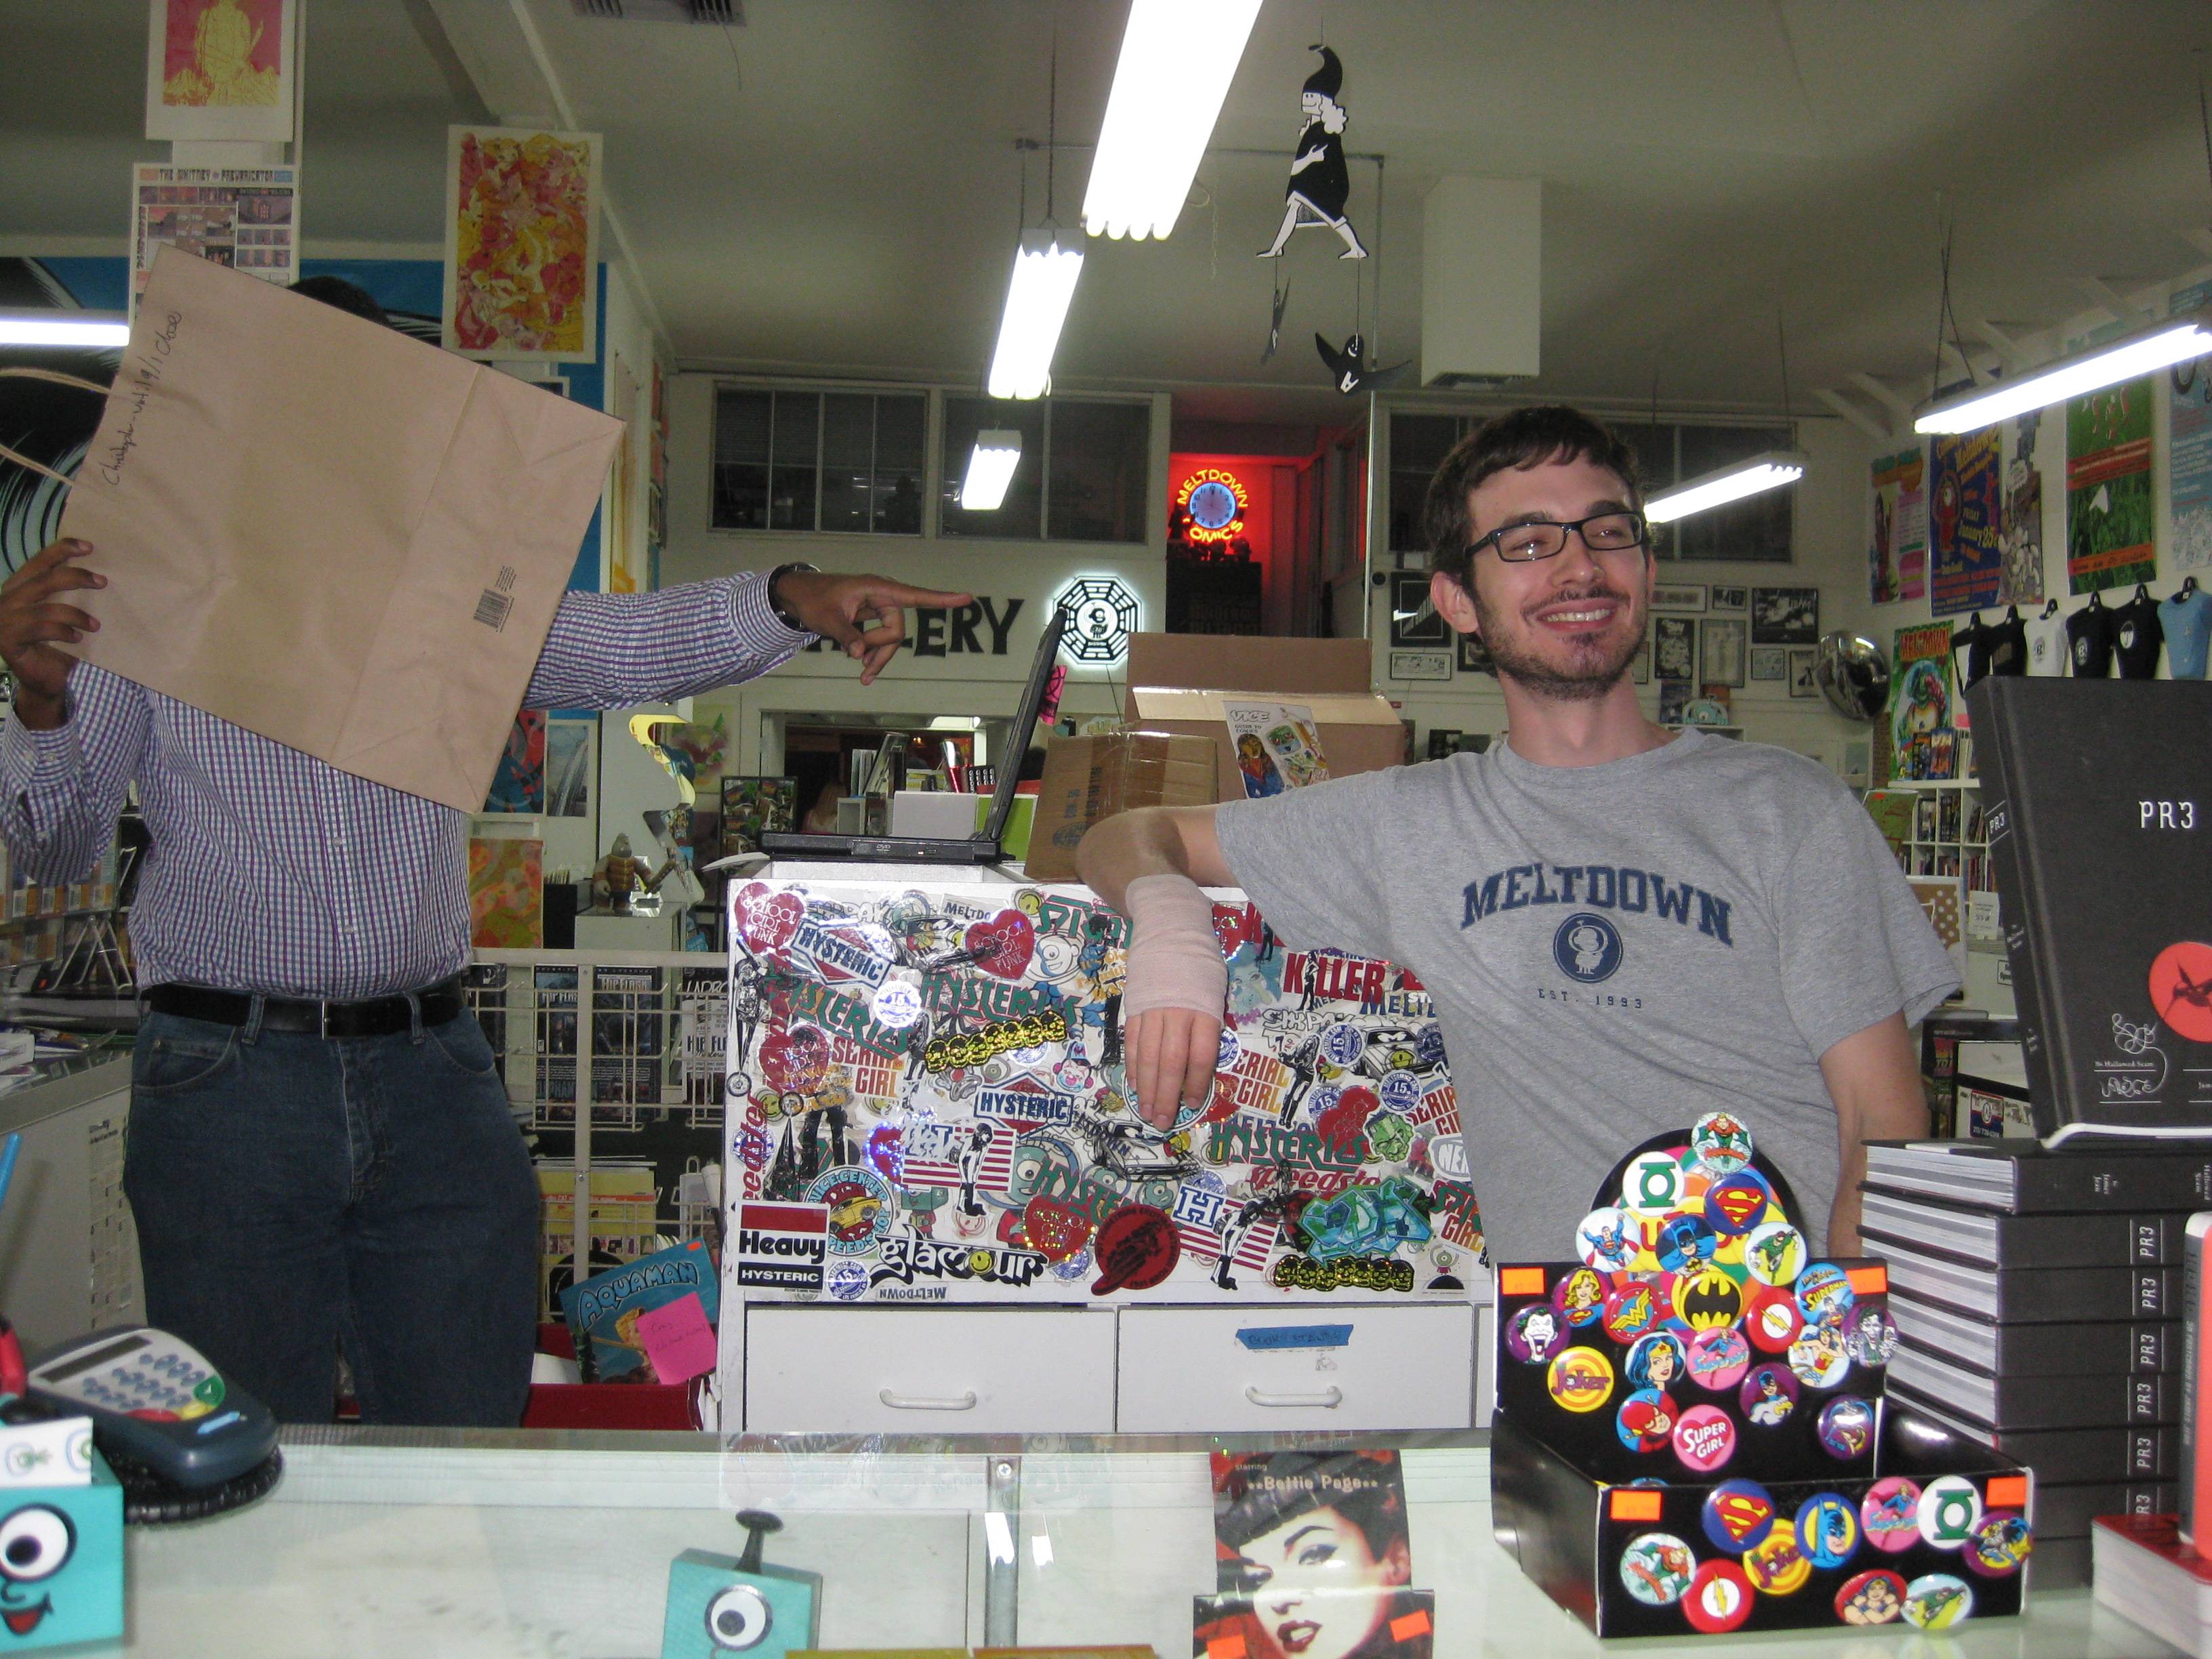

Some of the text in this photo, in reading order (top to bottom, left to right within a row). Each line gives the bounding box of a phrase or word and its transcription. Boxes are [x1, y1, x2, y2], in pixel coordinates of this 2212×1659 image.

[1177, 469, 1248, 508] MELTDOWN
[1183, 516, 1243, 542] OMICS
[1230, 710, 1270, 722] VICE
[1989, 812, 2005, 834] PR3
[2139, 800, 2194, 830] PR3
[742, 893, 798, 925] SCHOOL
[1459, 863, 1734, 948] MELTDOWN
[750, 911, 781, 933] GIRL
[798, 925, 884, 981] HYSTERIC
[995, 951, 1027, 972] FUNK
[1538, 987, 1643, 1009] EST. 1993
[855, 1067, 899, 1097] GIRL
[1231, 1048, 1291, 1088] ERIAL
[1237, 1079, 1282, 1114] GIRL
[1321, 1094, 1332, 1107] 15
[1394, 1082, 1408, 1093] 15
[981, 1091, 1068, 1120] HYSTERIC
[838, 1170, 888, 1202] CENTER
[739, 1230, 826, 1265] Heavy
[828, 1236, 865, 1254] PEED
[1441, 1215, 1483, 1253] GIRL
[2139, 1226, 2156, 1257] PR3
[741, 1269, 820, 1283] HYSTERIC
[579, 1262, 700, 1332] AQUAMAN
[879, 1286, 947, 1300] MELTDOWN
[2141, 1277, 2157, 1309] PR3
[2140, 1334, 2156, 1365] PR3
[2137, 1382, 2152, 1414] PR3
[1682, 1421, 1727, 1454] SUPER
[1696, 1433, 1725, 1459] GIRL
[2137, 1437, 2152, 1468] PR3
[1321, 1474, 1361, 1493] Page
